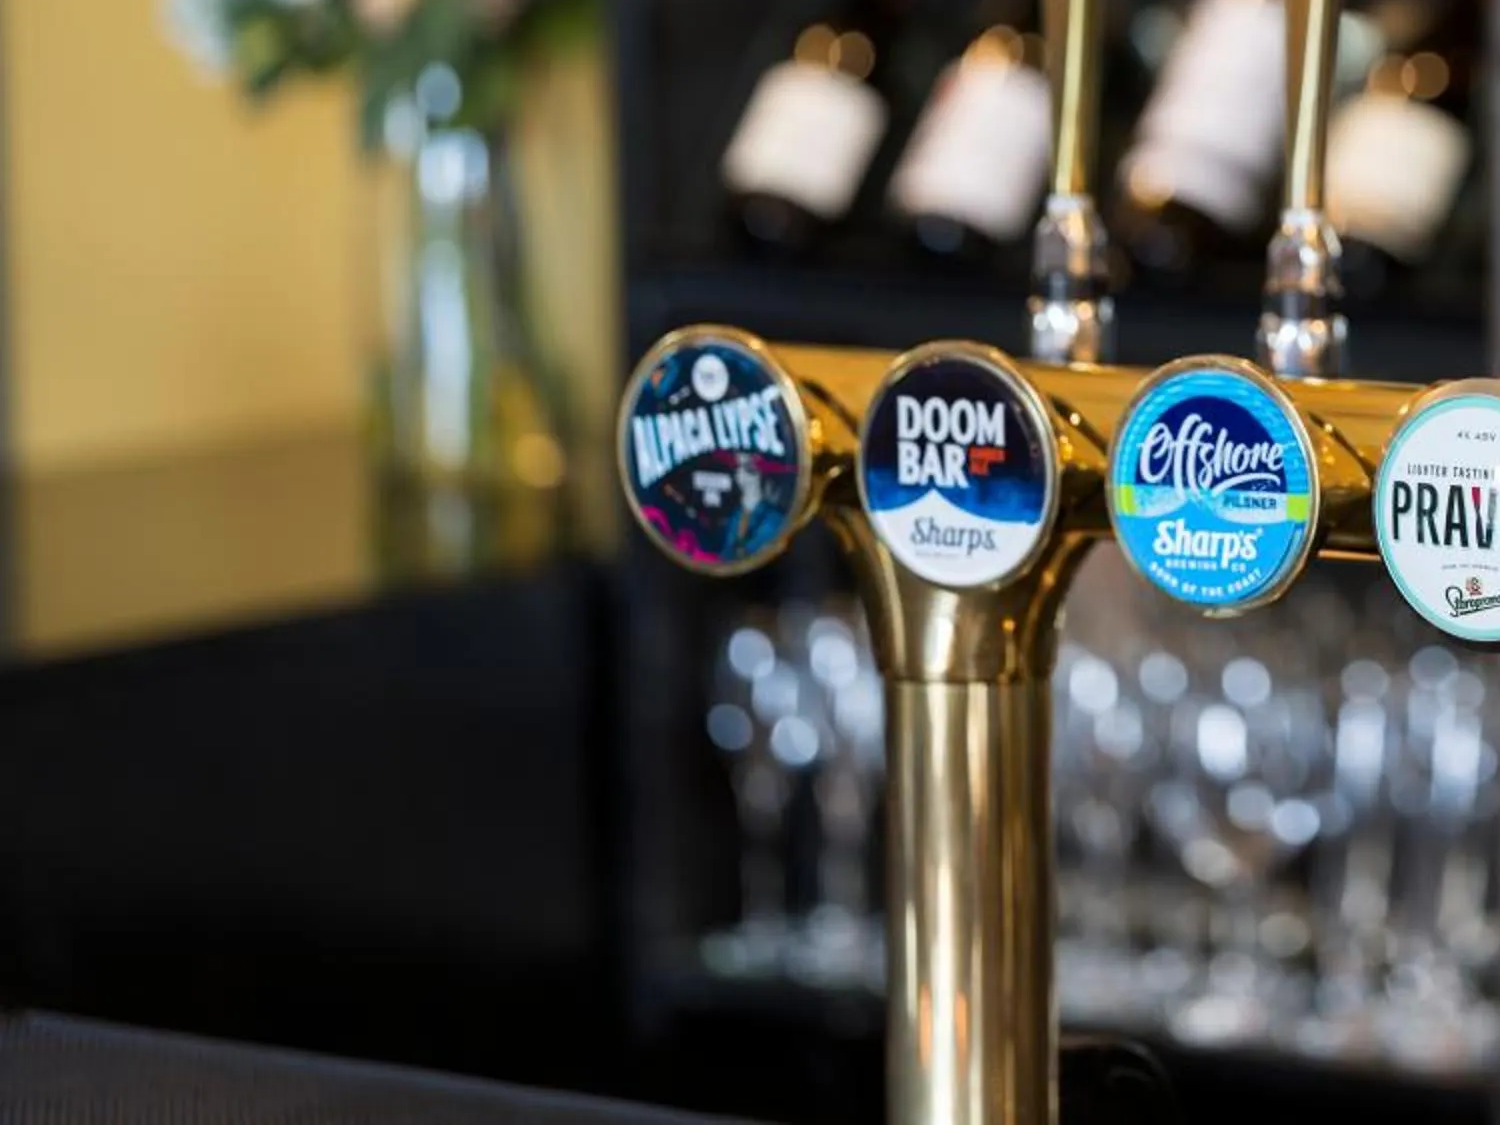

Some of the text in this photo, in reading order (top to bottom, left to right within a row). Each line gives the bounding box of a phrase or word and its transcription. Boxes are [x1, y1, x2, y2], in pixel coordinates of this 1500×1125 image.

[896, 395, 1007, 447] DOOM
[896, 441, 970, 490] BAR
[1138, 412, 1286, 502] Offshore
[1407, 462, 1448, 478] LIGHTER
